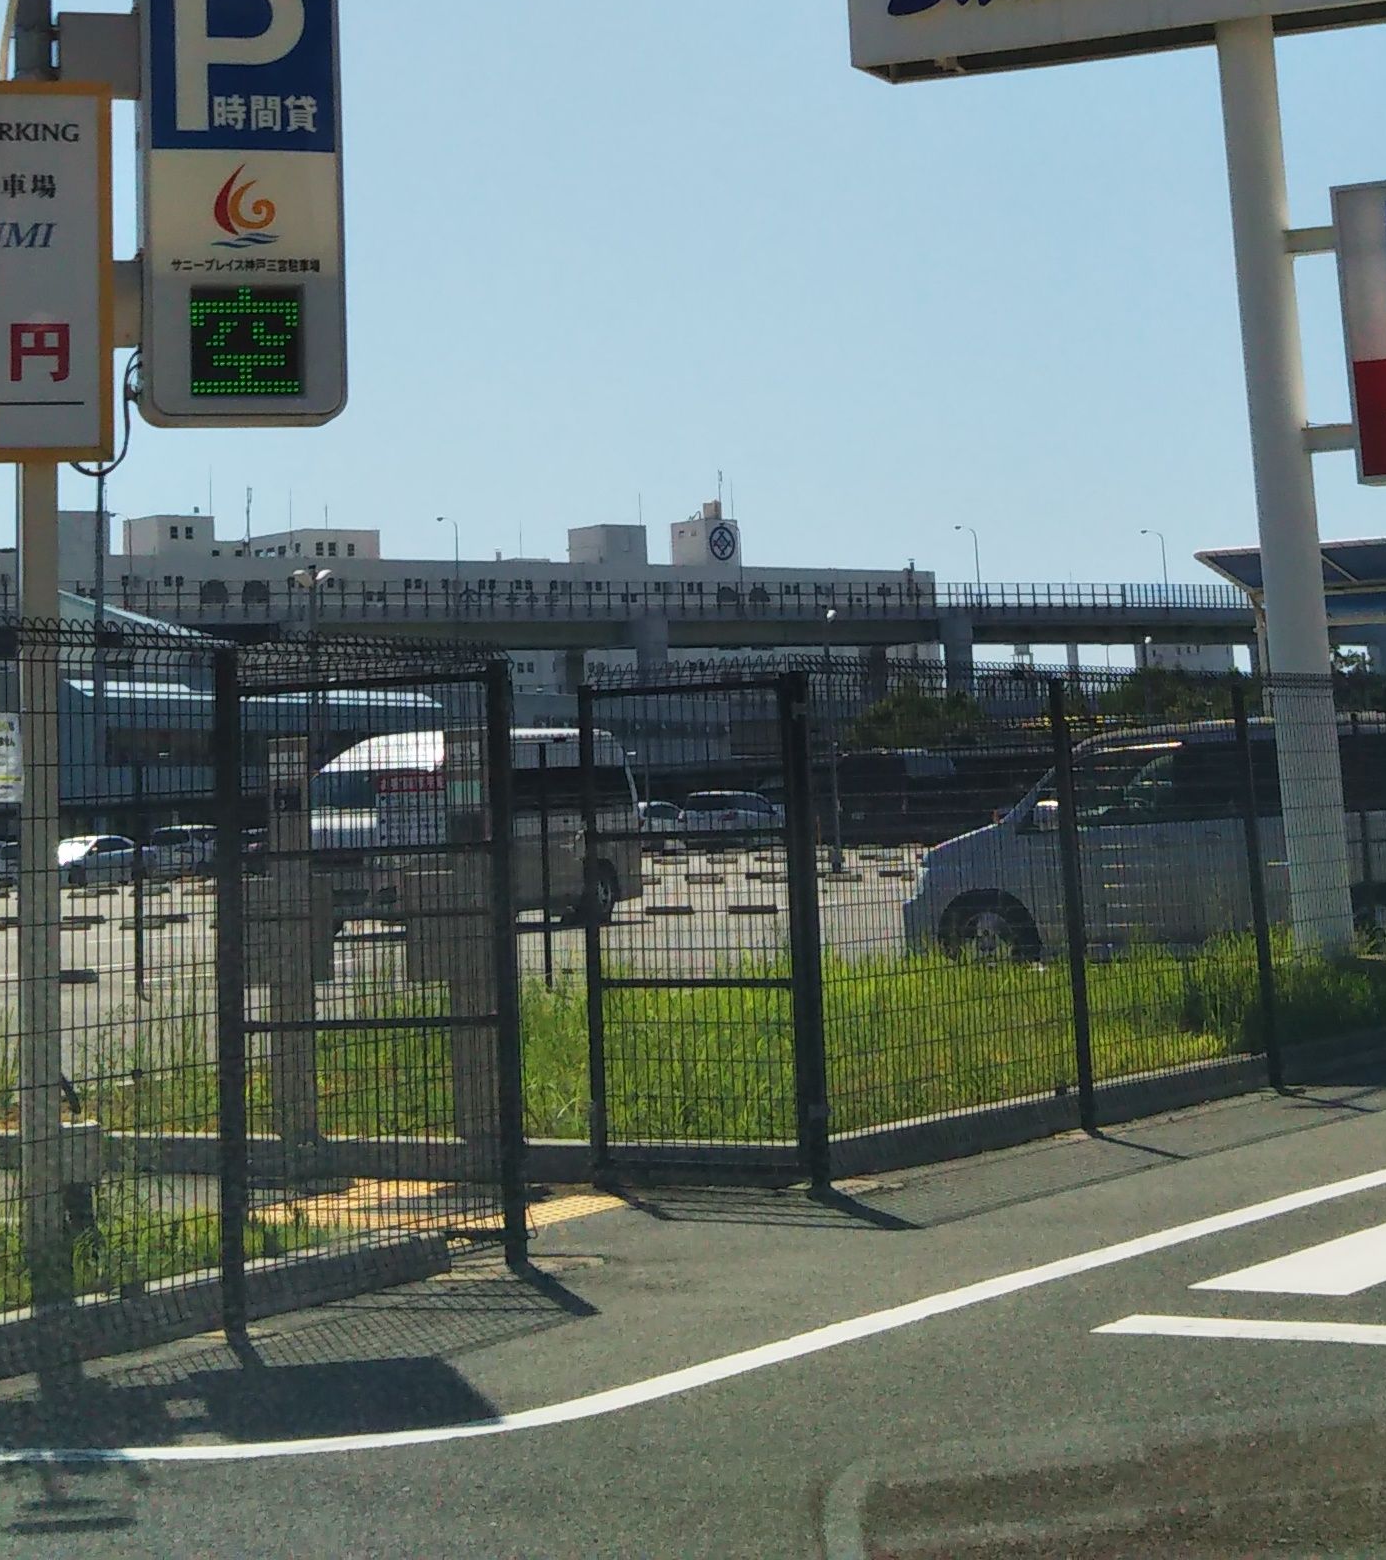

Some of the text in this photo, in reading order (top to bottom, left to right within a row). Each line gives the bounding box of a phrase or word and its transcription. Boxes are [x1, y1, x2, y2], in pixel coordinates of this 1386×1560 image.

[213, 95, 318, 134] 時間貸
[9, 322, 71, 384] 円
[189, 286, 301, 394] 空
